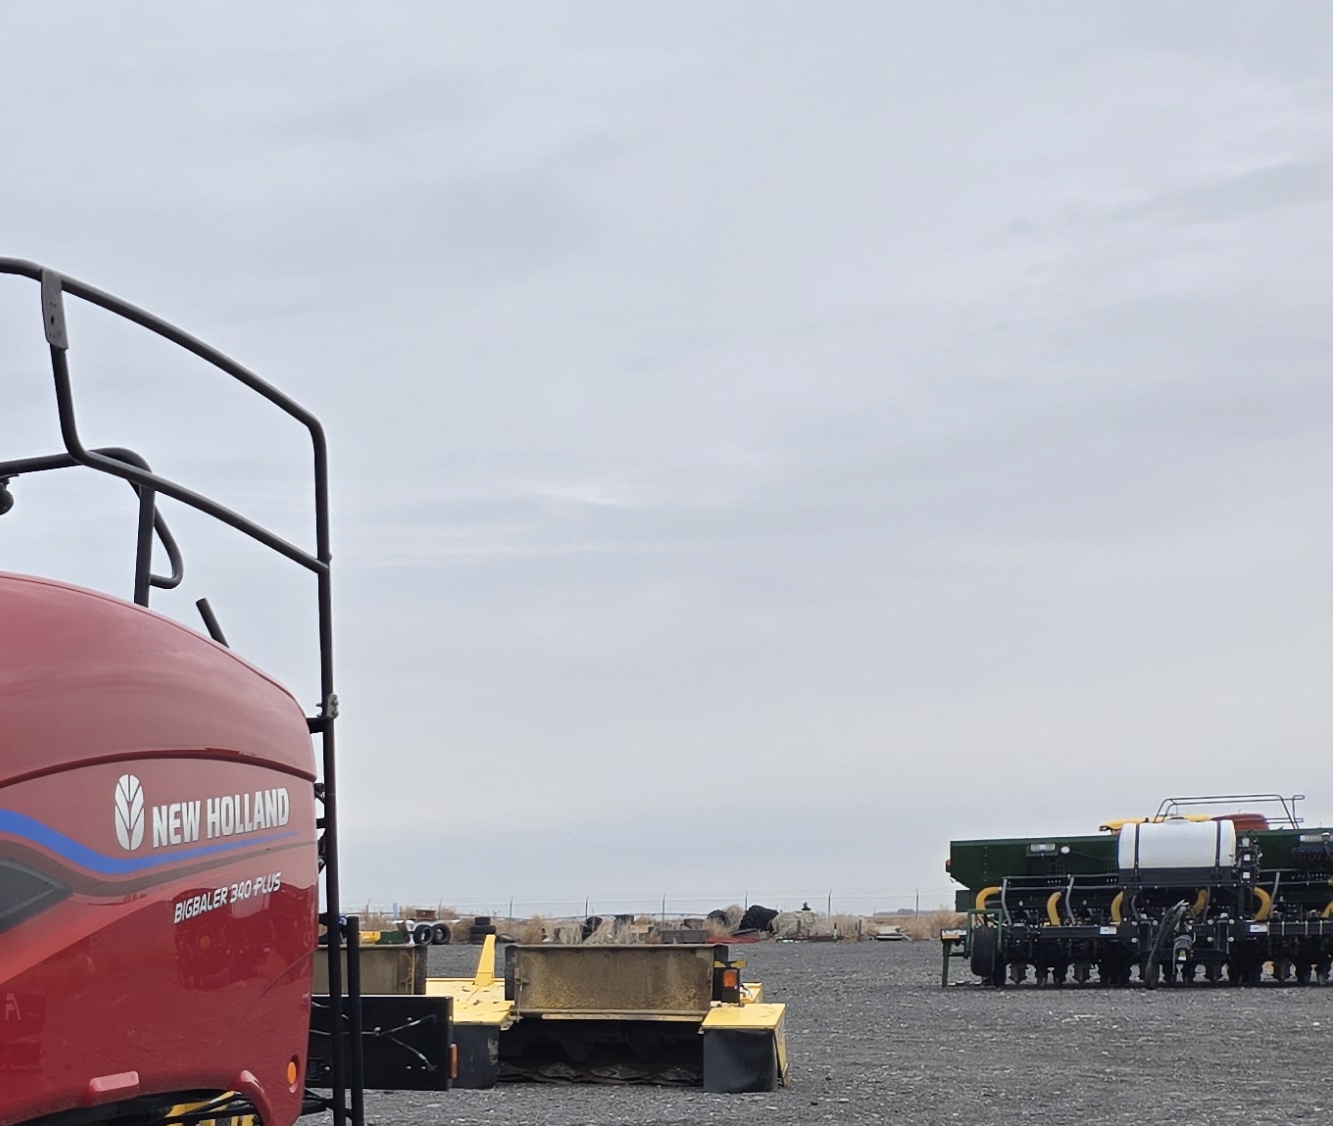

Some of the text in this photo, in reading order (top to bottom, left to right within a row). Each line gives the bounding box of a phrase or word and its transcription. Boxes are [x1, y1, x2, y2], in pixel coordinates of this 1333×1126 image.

[152, 787, 290, 848] NEW HOLLAND
[173, 886, 228, 924] BIGBALER
[229, 879, 252, 904] 340
